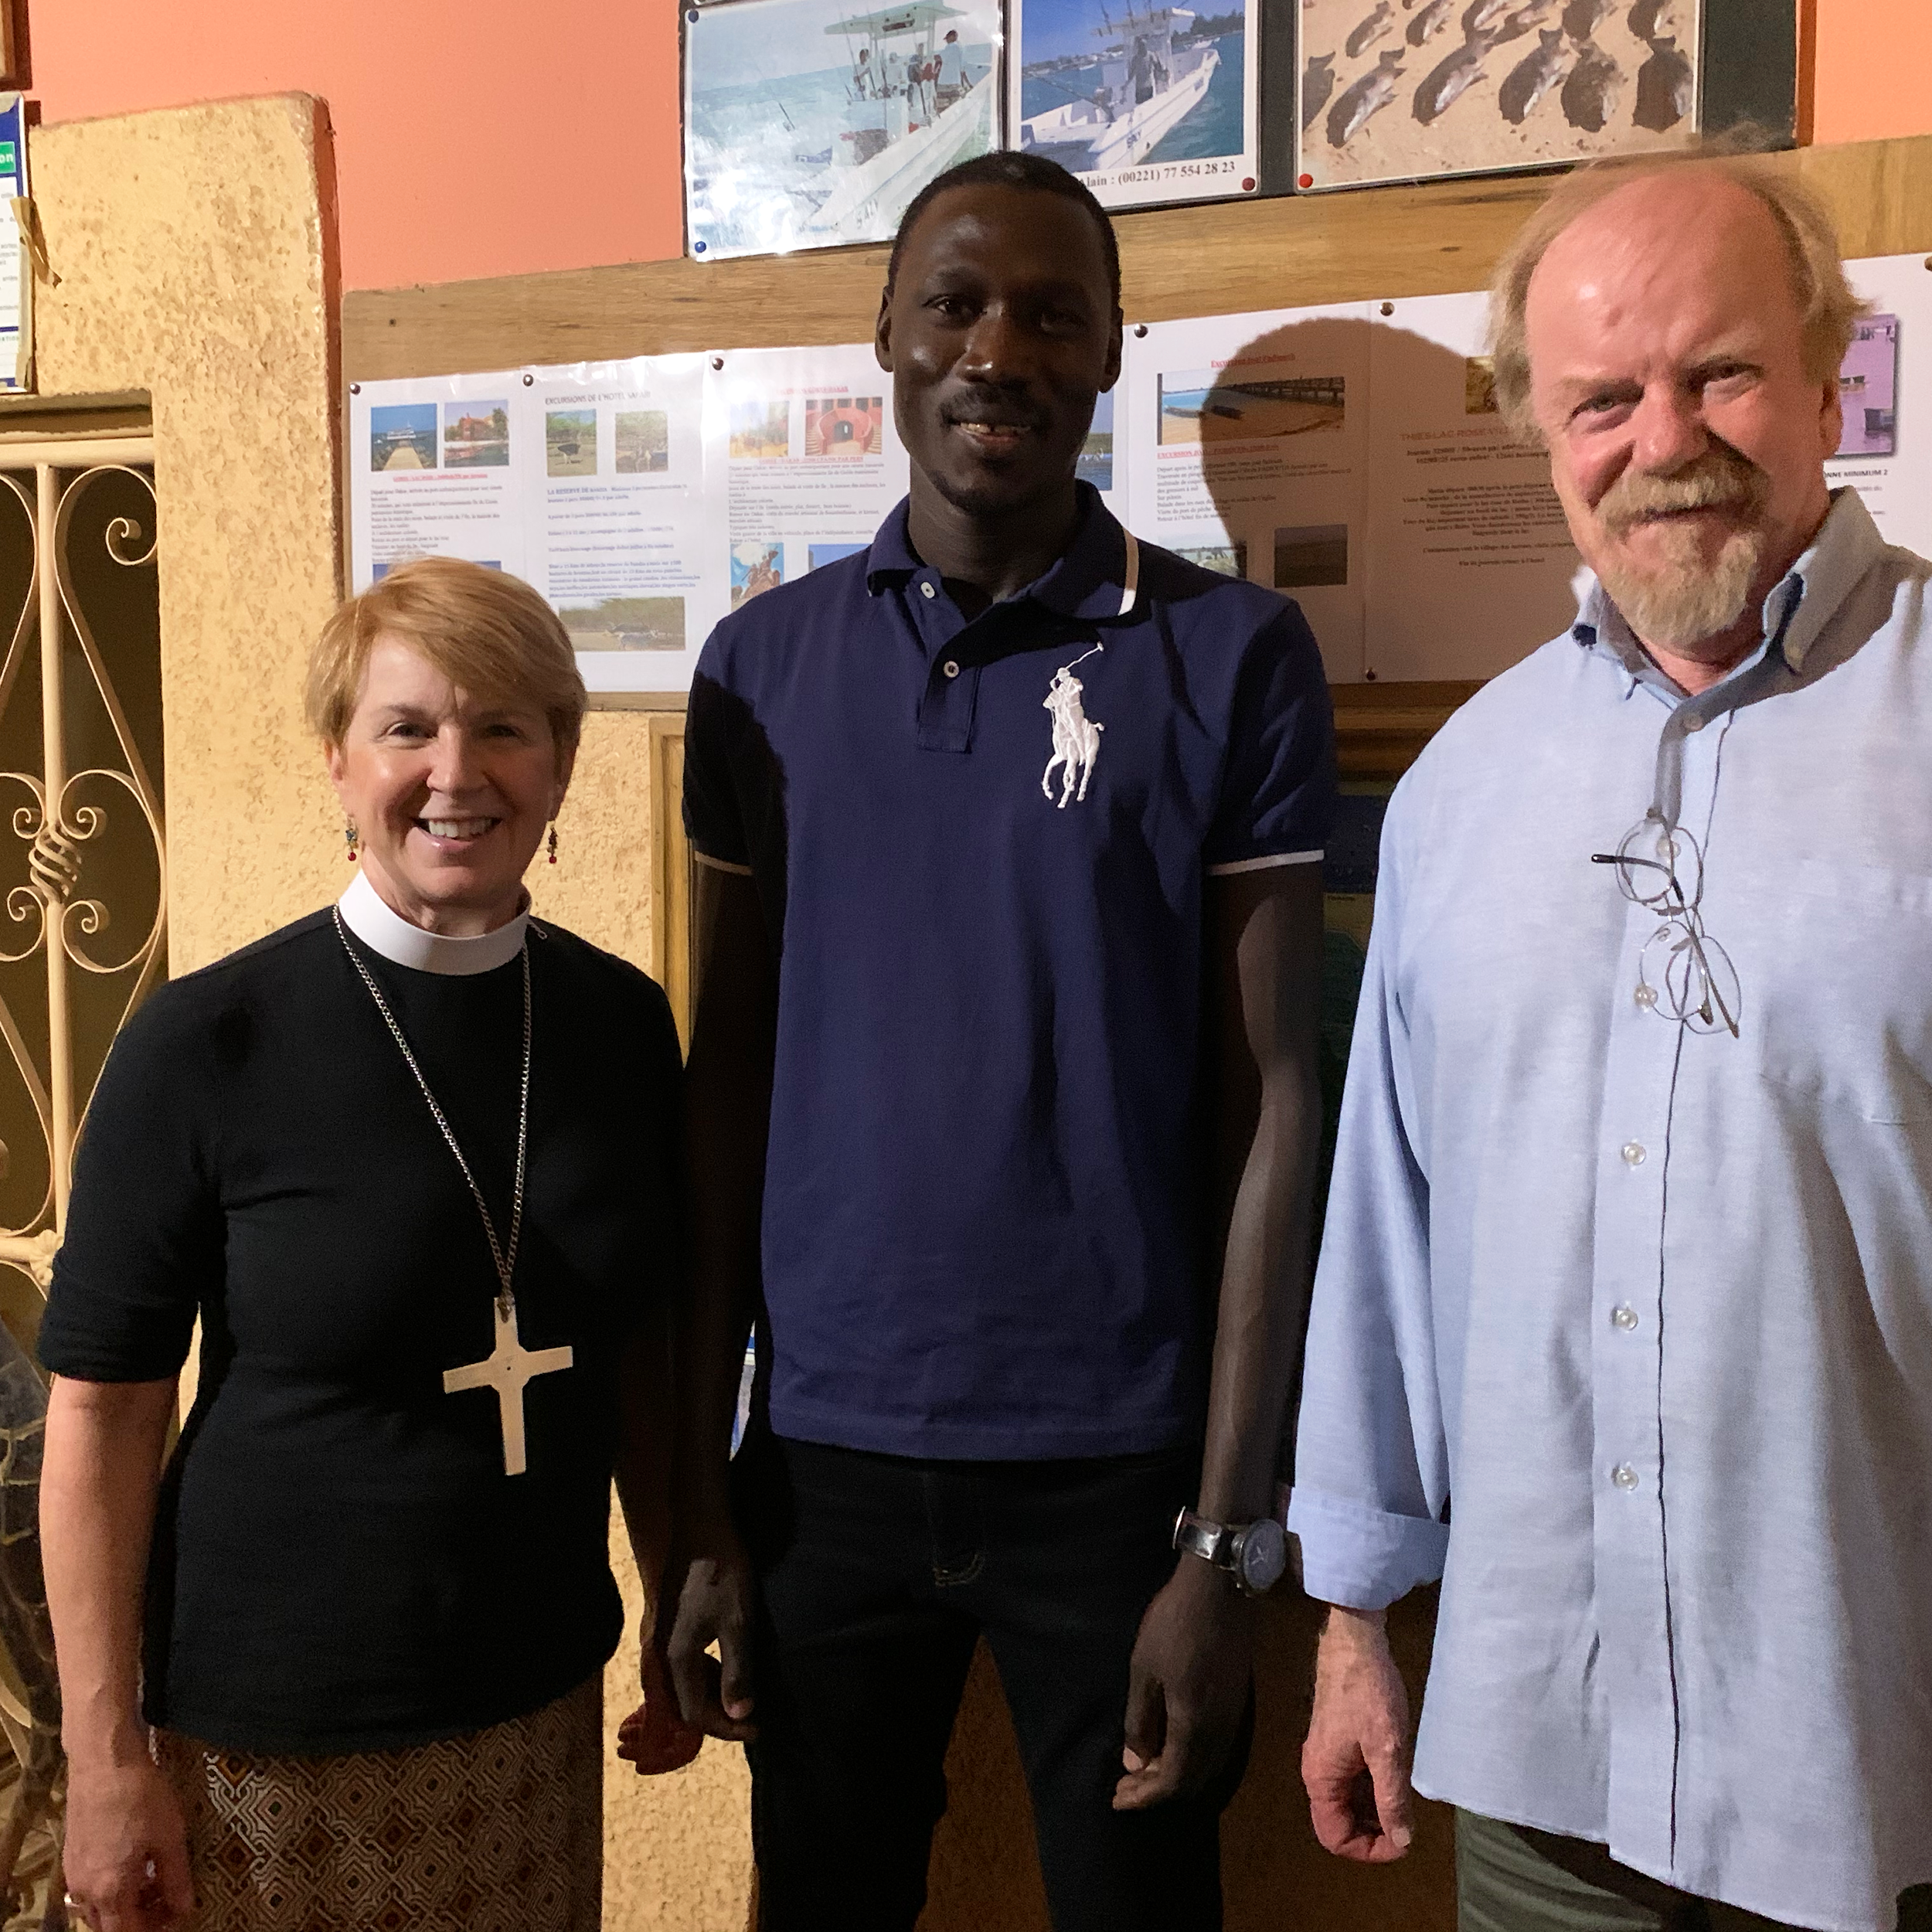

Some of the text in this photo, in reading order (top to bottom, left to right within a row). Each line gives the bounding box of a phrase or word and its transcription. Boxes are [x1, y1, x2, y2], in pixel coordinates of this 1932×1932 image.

[1118, 169, 1160, 186] (00221)
[1164, 167, 1177, 179] 77
[1180, 165, 1200, 177] 554
[1204, 163, 1218, 175] 28
[1221, 161, 1235, 173] 23
